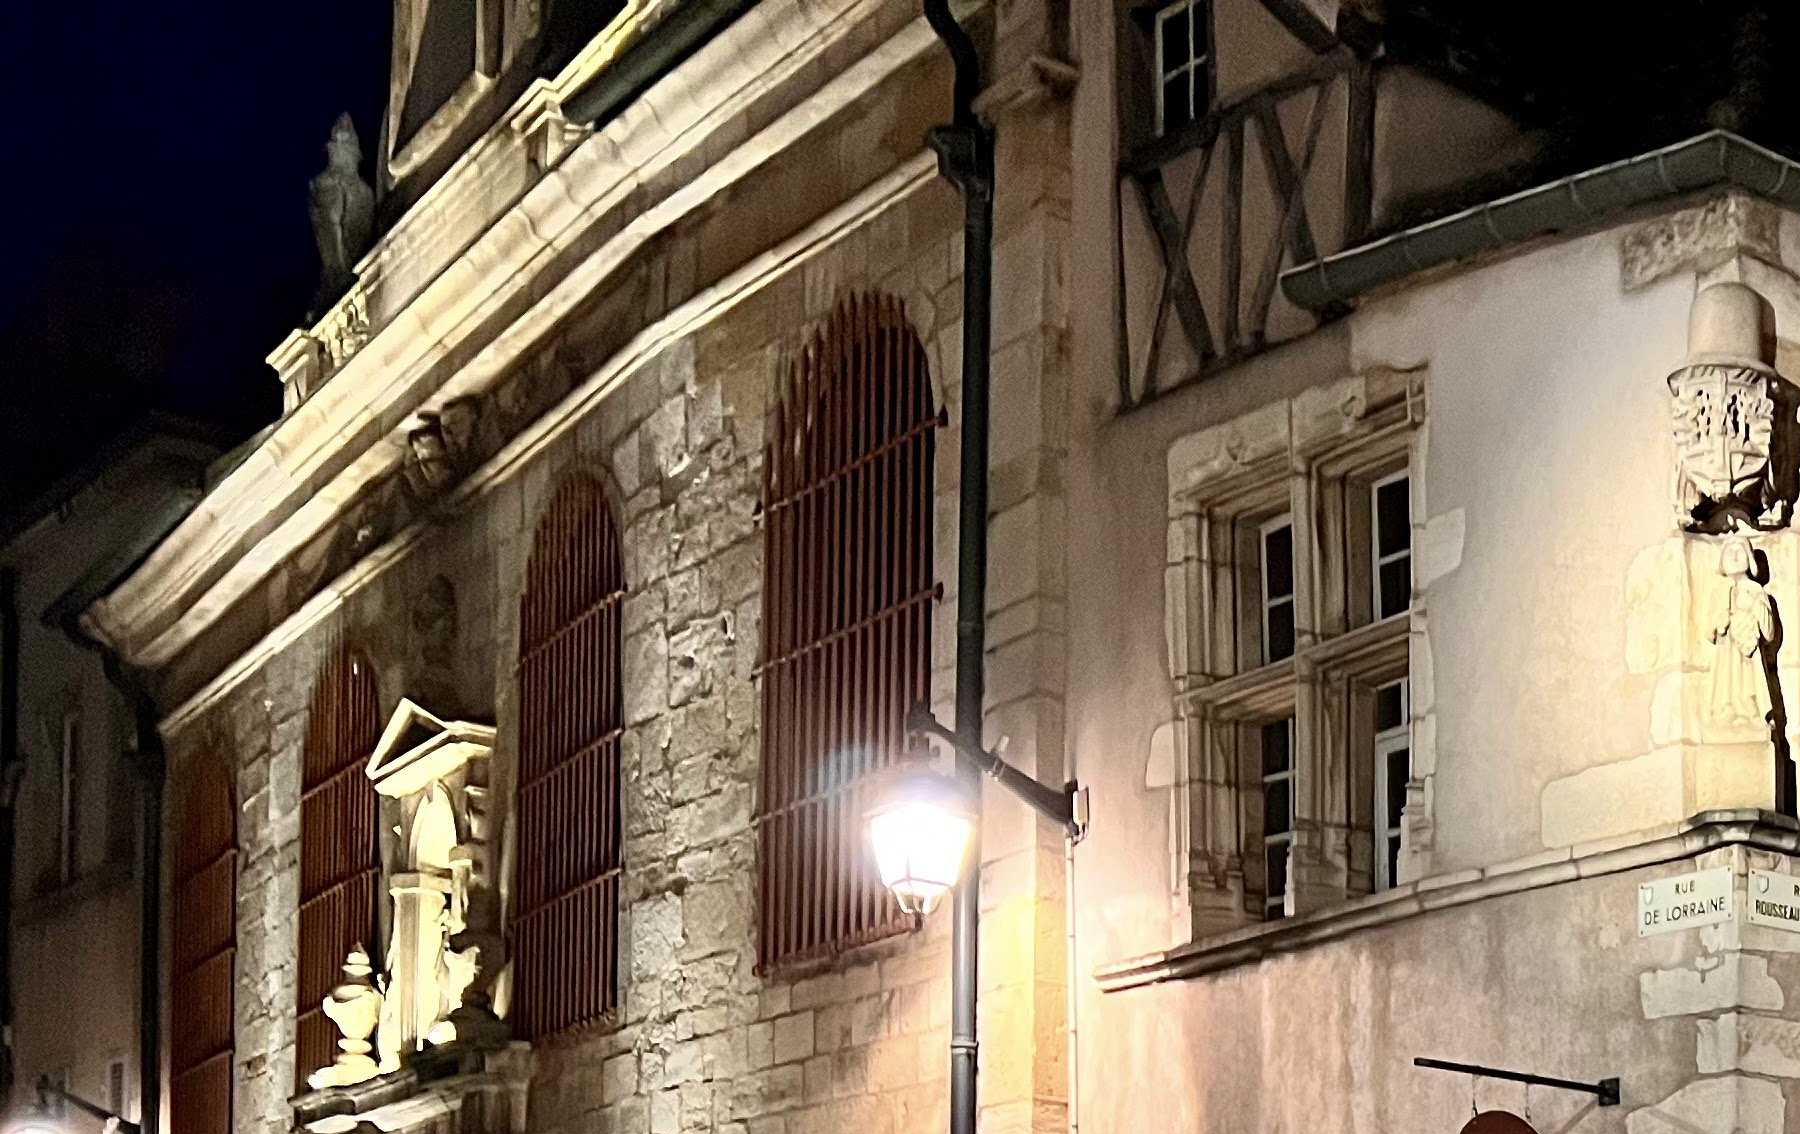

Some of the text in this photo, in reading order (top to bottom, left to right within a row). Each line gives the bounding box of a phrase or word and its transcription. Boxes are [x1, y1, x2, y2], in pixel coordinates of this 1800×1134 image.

[1674, 880, 1696, 896] RUE
[1644, 896, 1726, 926] DE LORRAINE
[1755, 899, 1800, 922] ROUSSEAU
